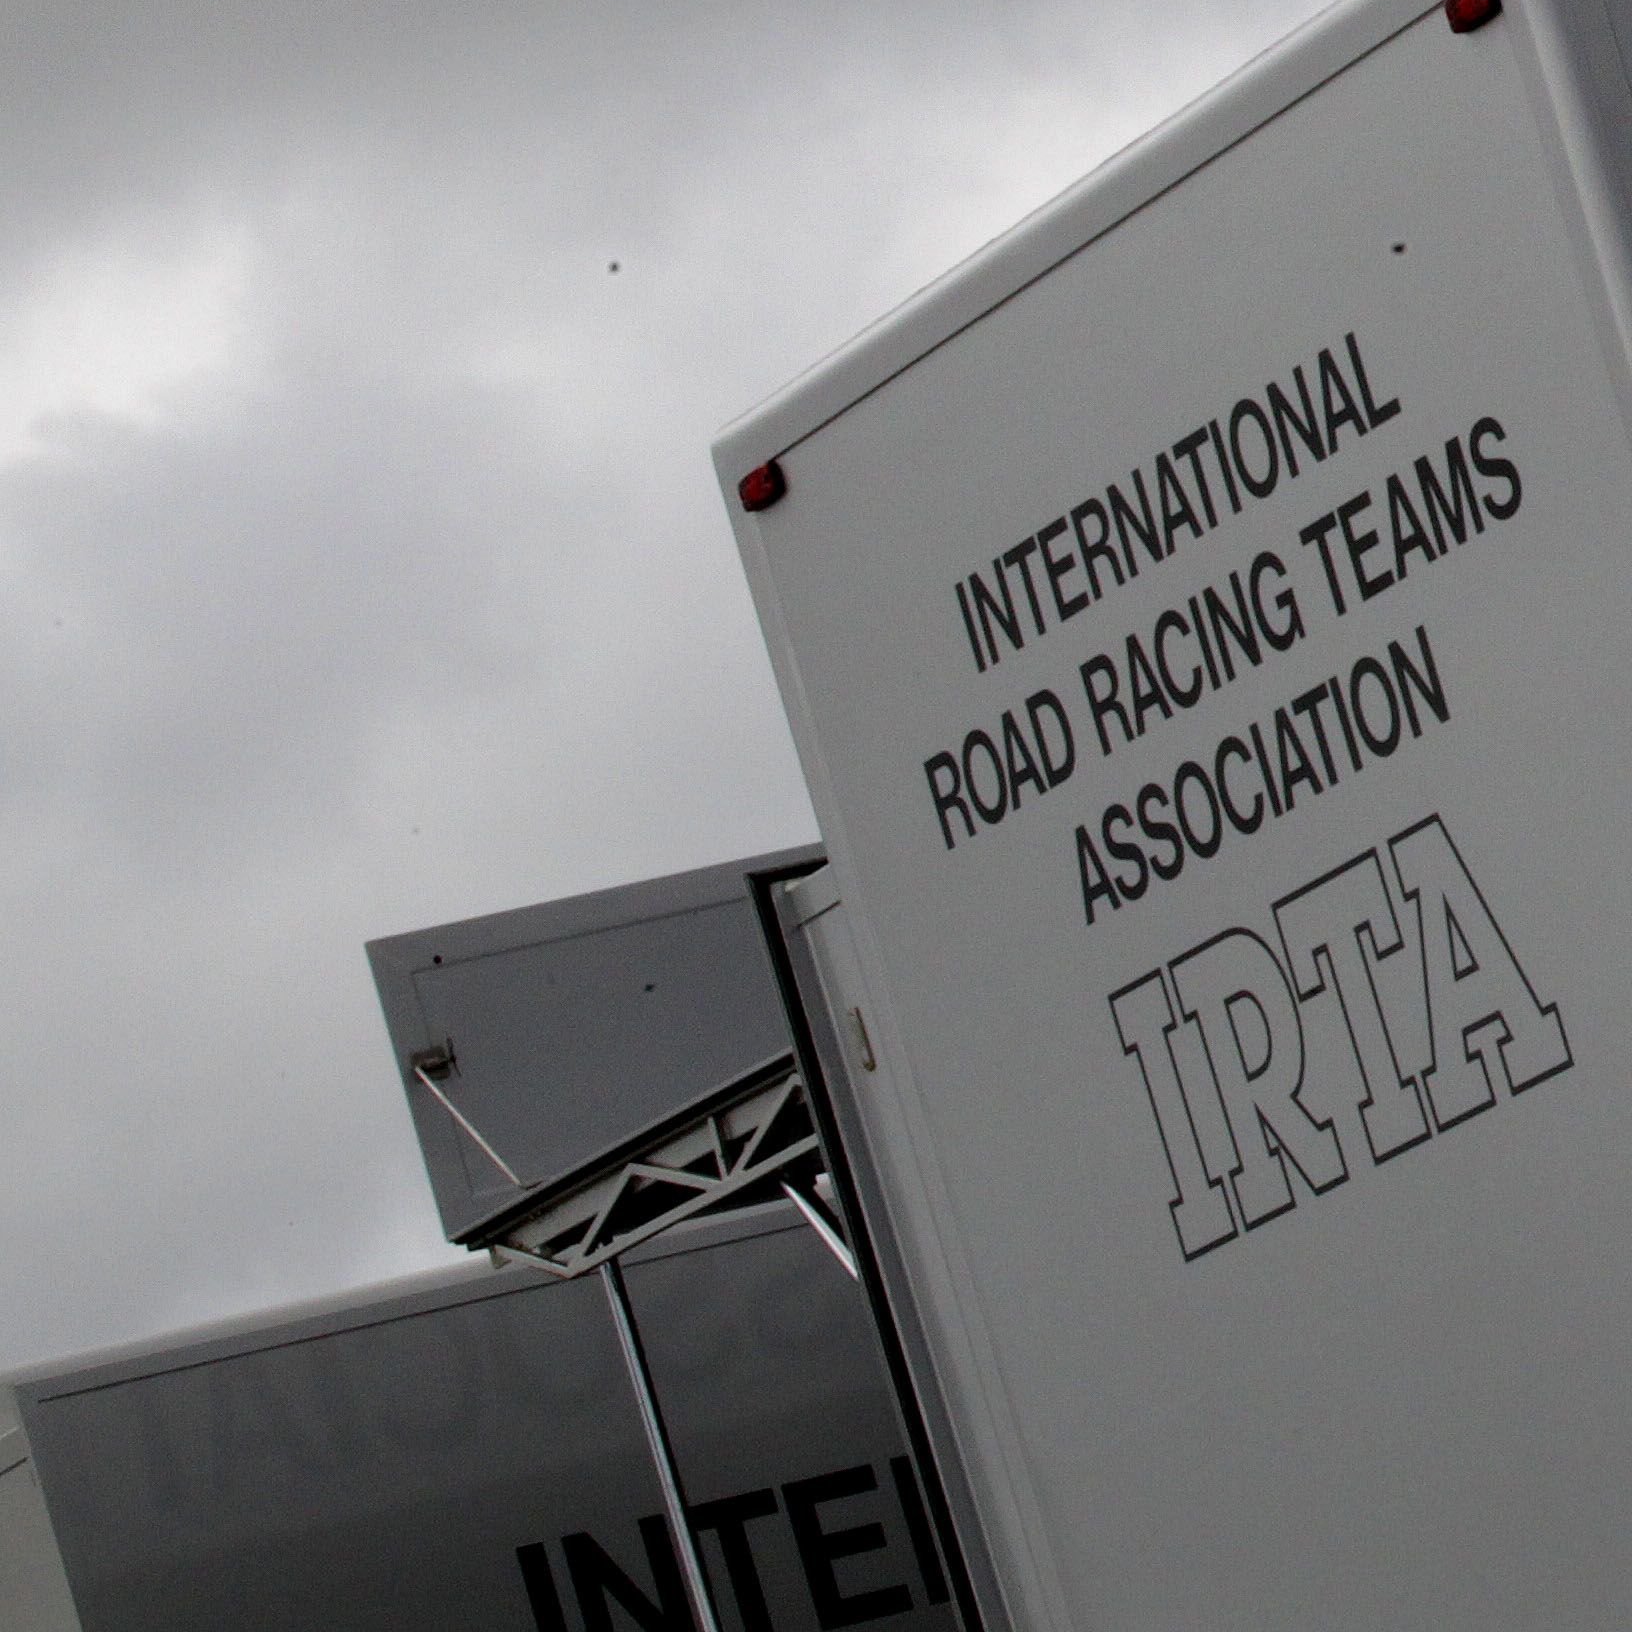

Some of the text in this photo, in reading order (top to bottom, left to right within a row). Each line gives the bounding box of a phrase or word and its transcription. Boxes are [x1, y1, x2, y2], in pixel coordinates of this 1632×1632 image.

[923, 415, 1523, 850] ROAD RACING TEAMS
[955, 332, 1402, 673] INTERNATIONAL
[1074, 625, 1451, 926] ASSOCIATION
[1107, 812, 1576, 1263] IRTA
[515, 1455, 951, 1632] INTE
